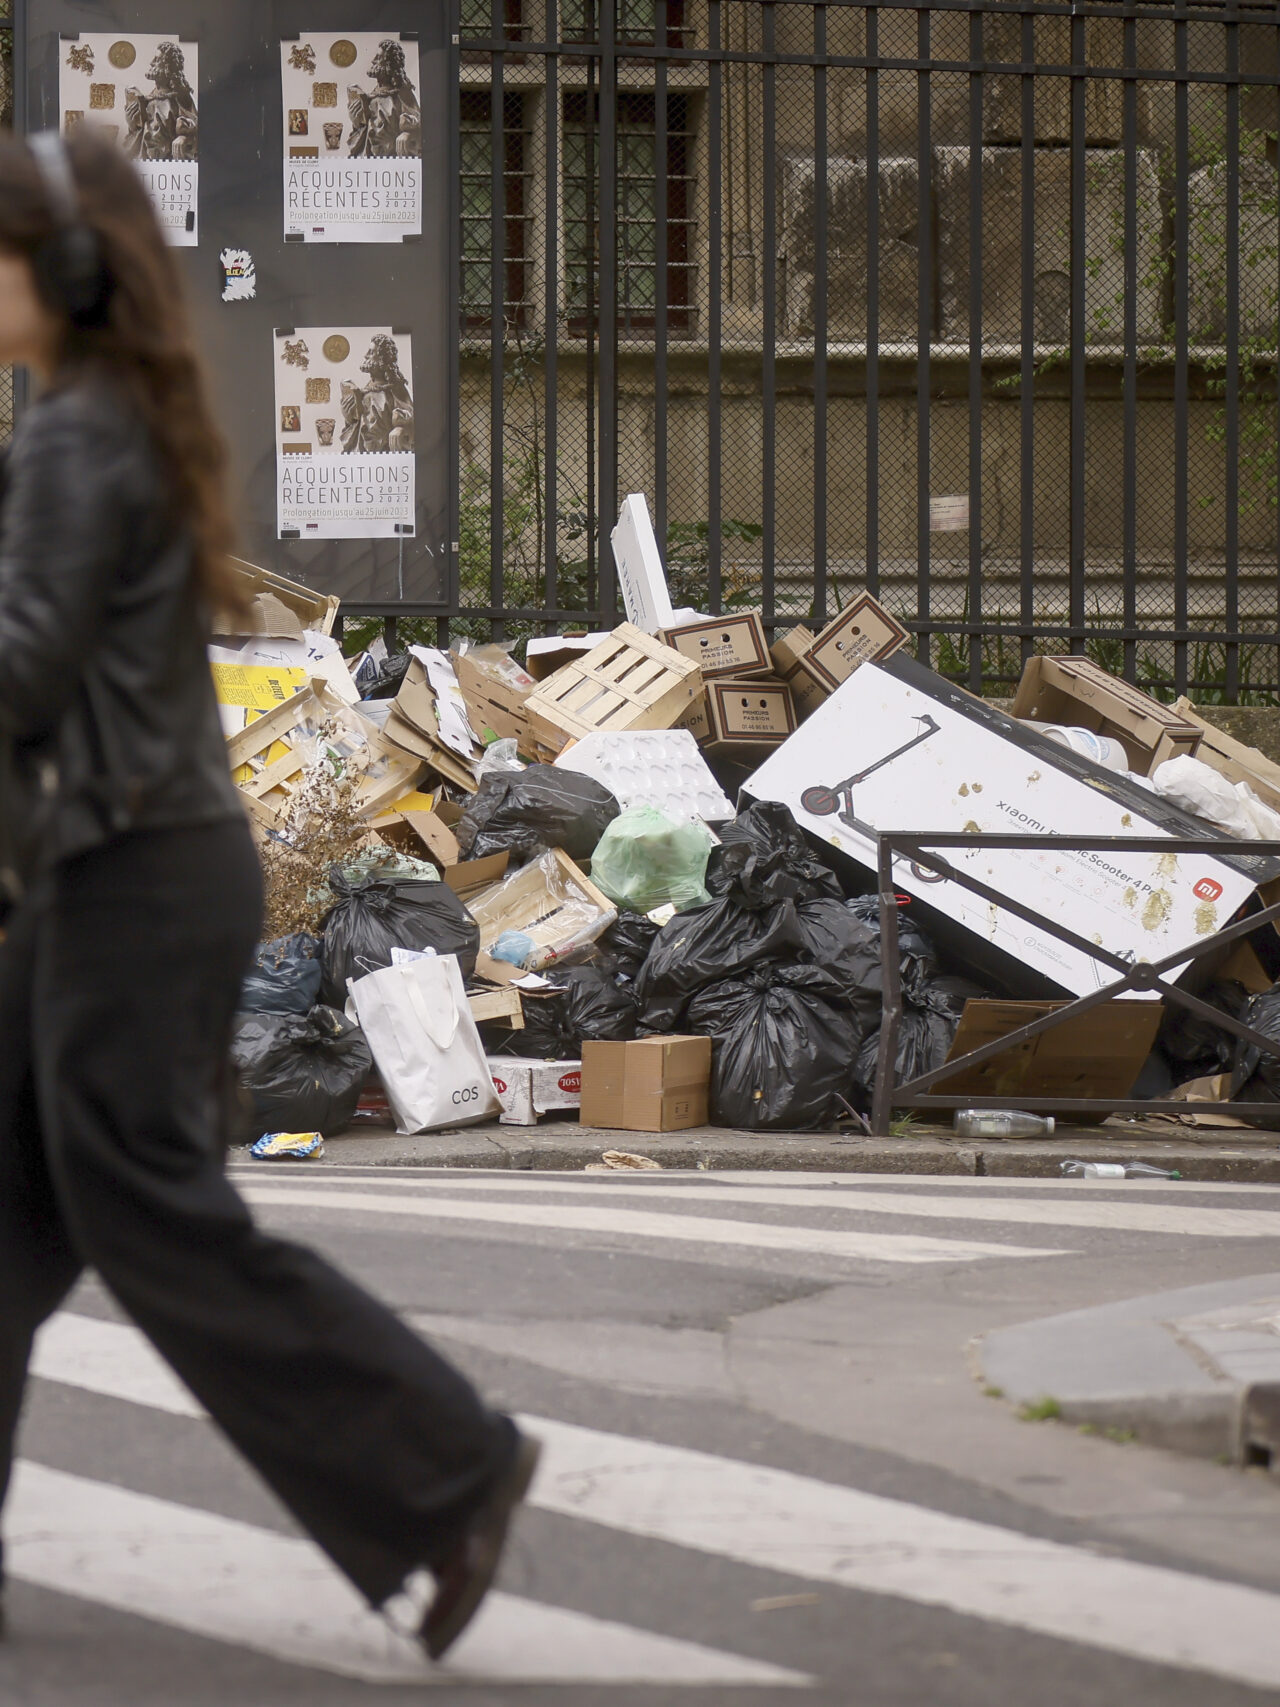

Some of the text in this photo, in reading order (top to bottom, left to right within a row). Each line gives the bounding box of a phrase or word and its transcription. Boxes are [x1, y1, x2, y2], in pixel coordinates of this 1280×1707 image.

[288, 171, 416, 190] ACQUISITIONS
[161, 193, 192, 202] 2017
[161, 203, 192, 211] 2022
[289, 188, 380, 208] RÉCENTES
[290, 211, 416, 221] Prolongation jusqu'au 25 juin 2023
[282, 466, 410, 486] ACQUISITIONS
[283, 485, 374, 504] RÉCENTES
[283, 508, 332, 518] Prolongation
[332, 508, 364, 518] jusqu'au
[365, 507, 374, 516] 25
[375, 507, 389, 517] juin
[700, 644, 733, 654] PRIMEURS
[702, 649, 735, 659] PASSION
[842, 634, 868, 659] PRIMEURS
[846, 638, 872, 663] PASSION
[1089, 853, 1133, 883] Scooter
[1133, 880, 1143, 888] 4
[452, 1086, 479, 1105] COS
